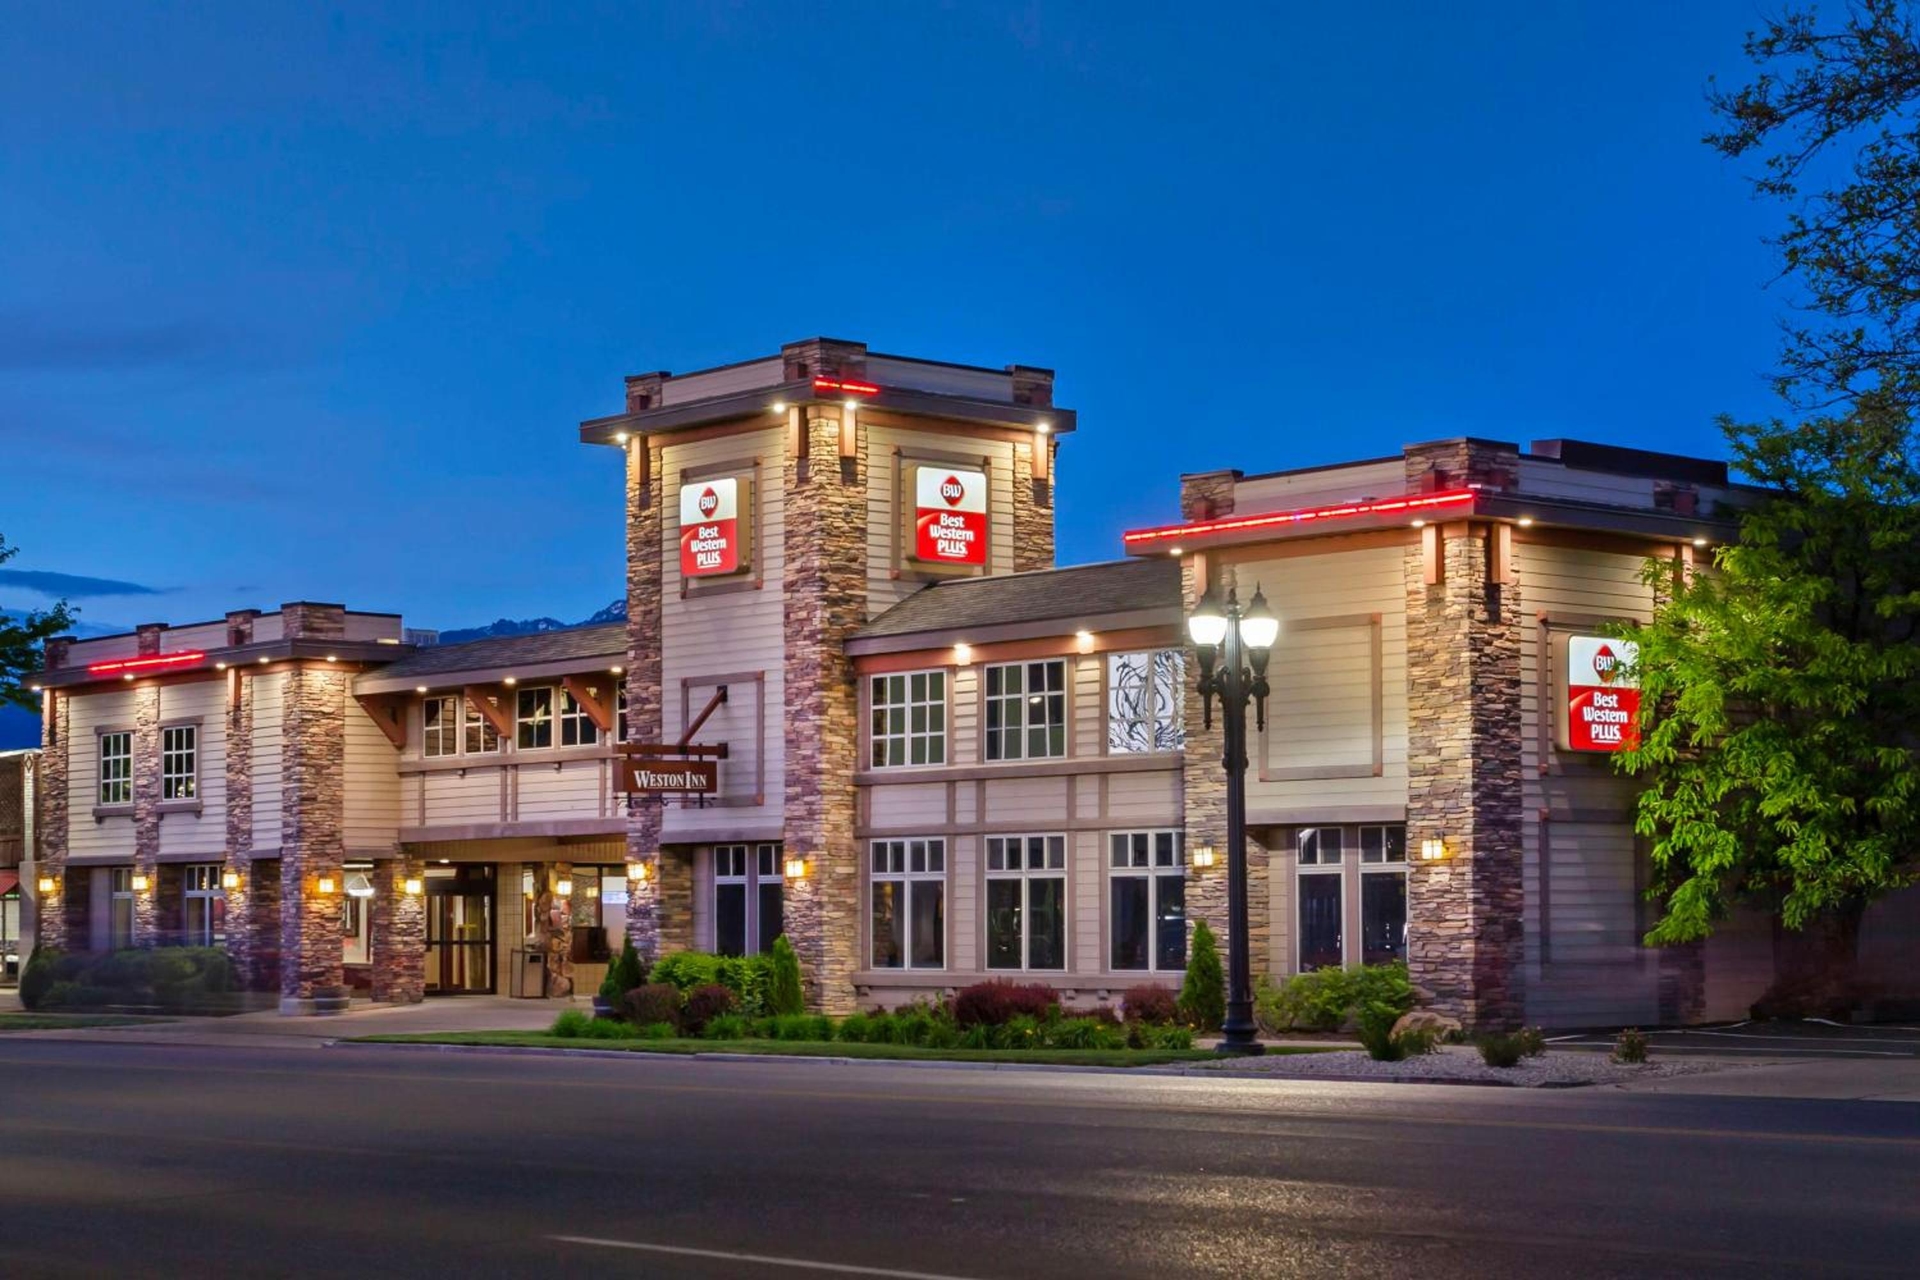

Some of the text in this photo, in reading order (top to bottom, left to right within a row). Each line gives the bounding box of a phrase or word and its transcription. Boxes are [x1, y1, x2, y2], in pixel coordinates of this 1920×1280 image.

[940, 513, 964, 528] Best
[698, 526, 718, 538] Best
[930, 525, 973, 541] Western
[691, 538, 726, 551] Western
[1594, 692, 1617, 707] Best
[1583, 707, 1627, 723] Western
[634, 771, 706, 788] WESTON INN
